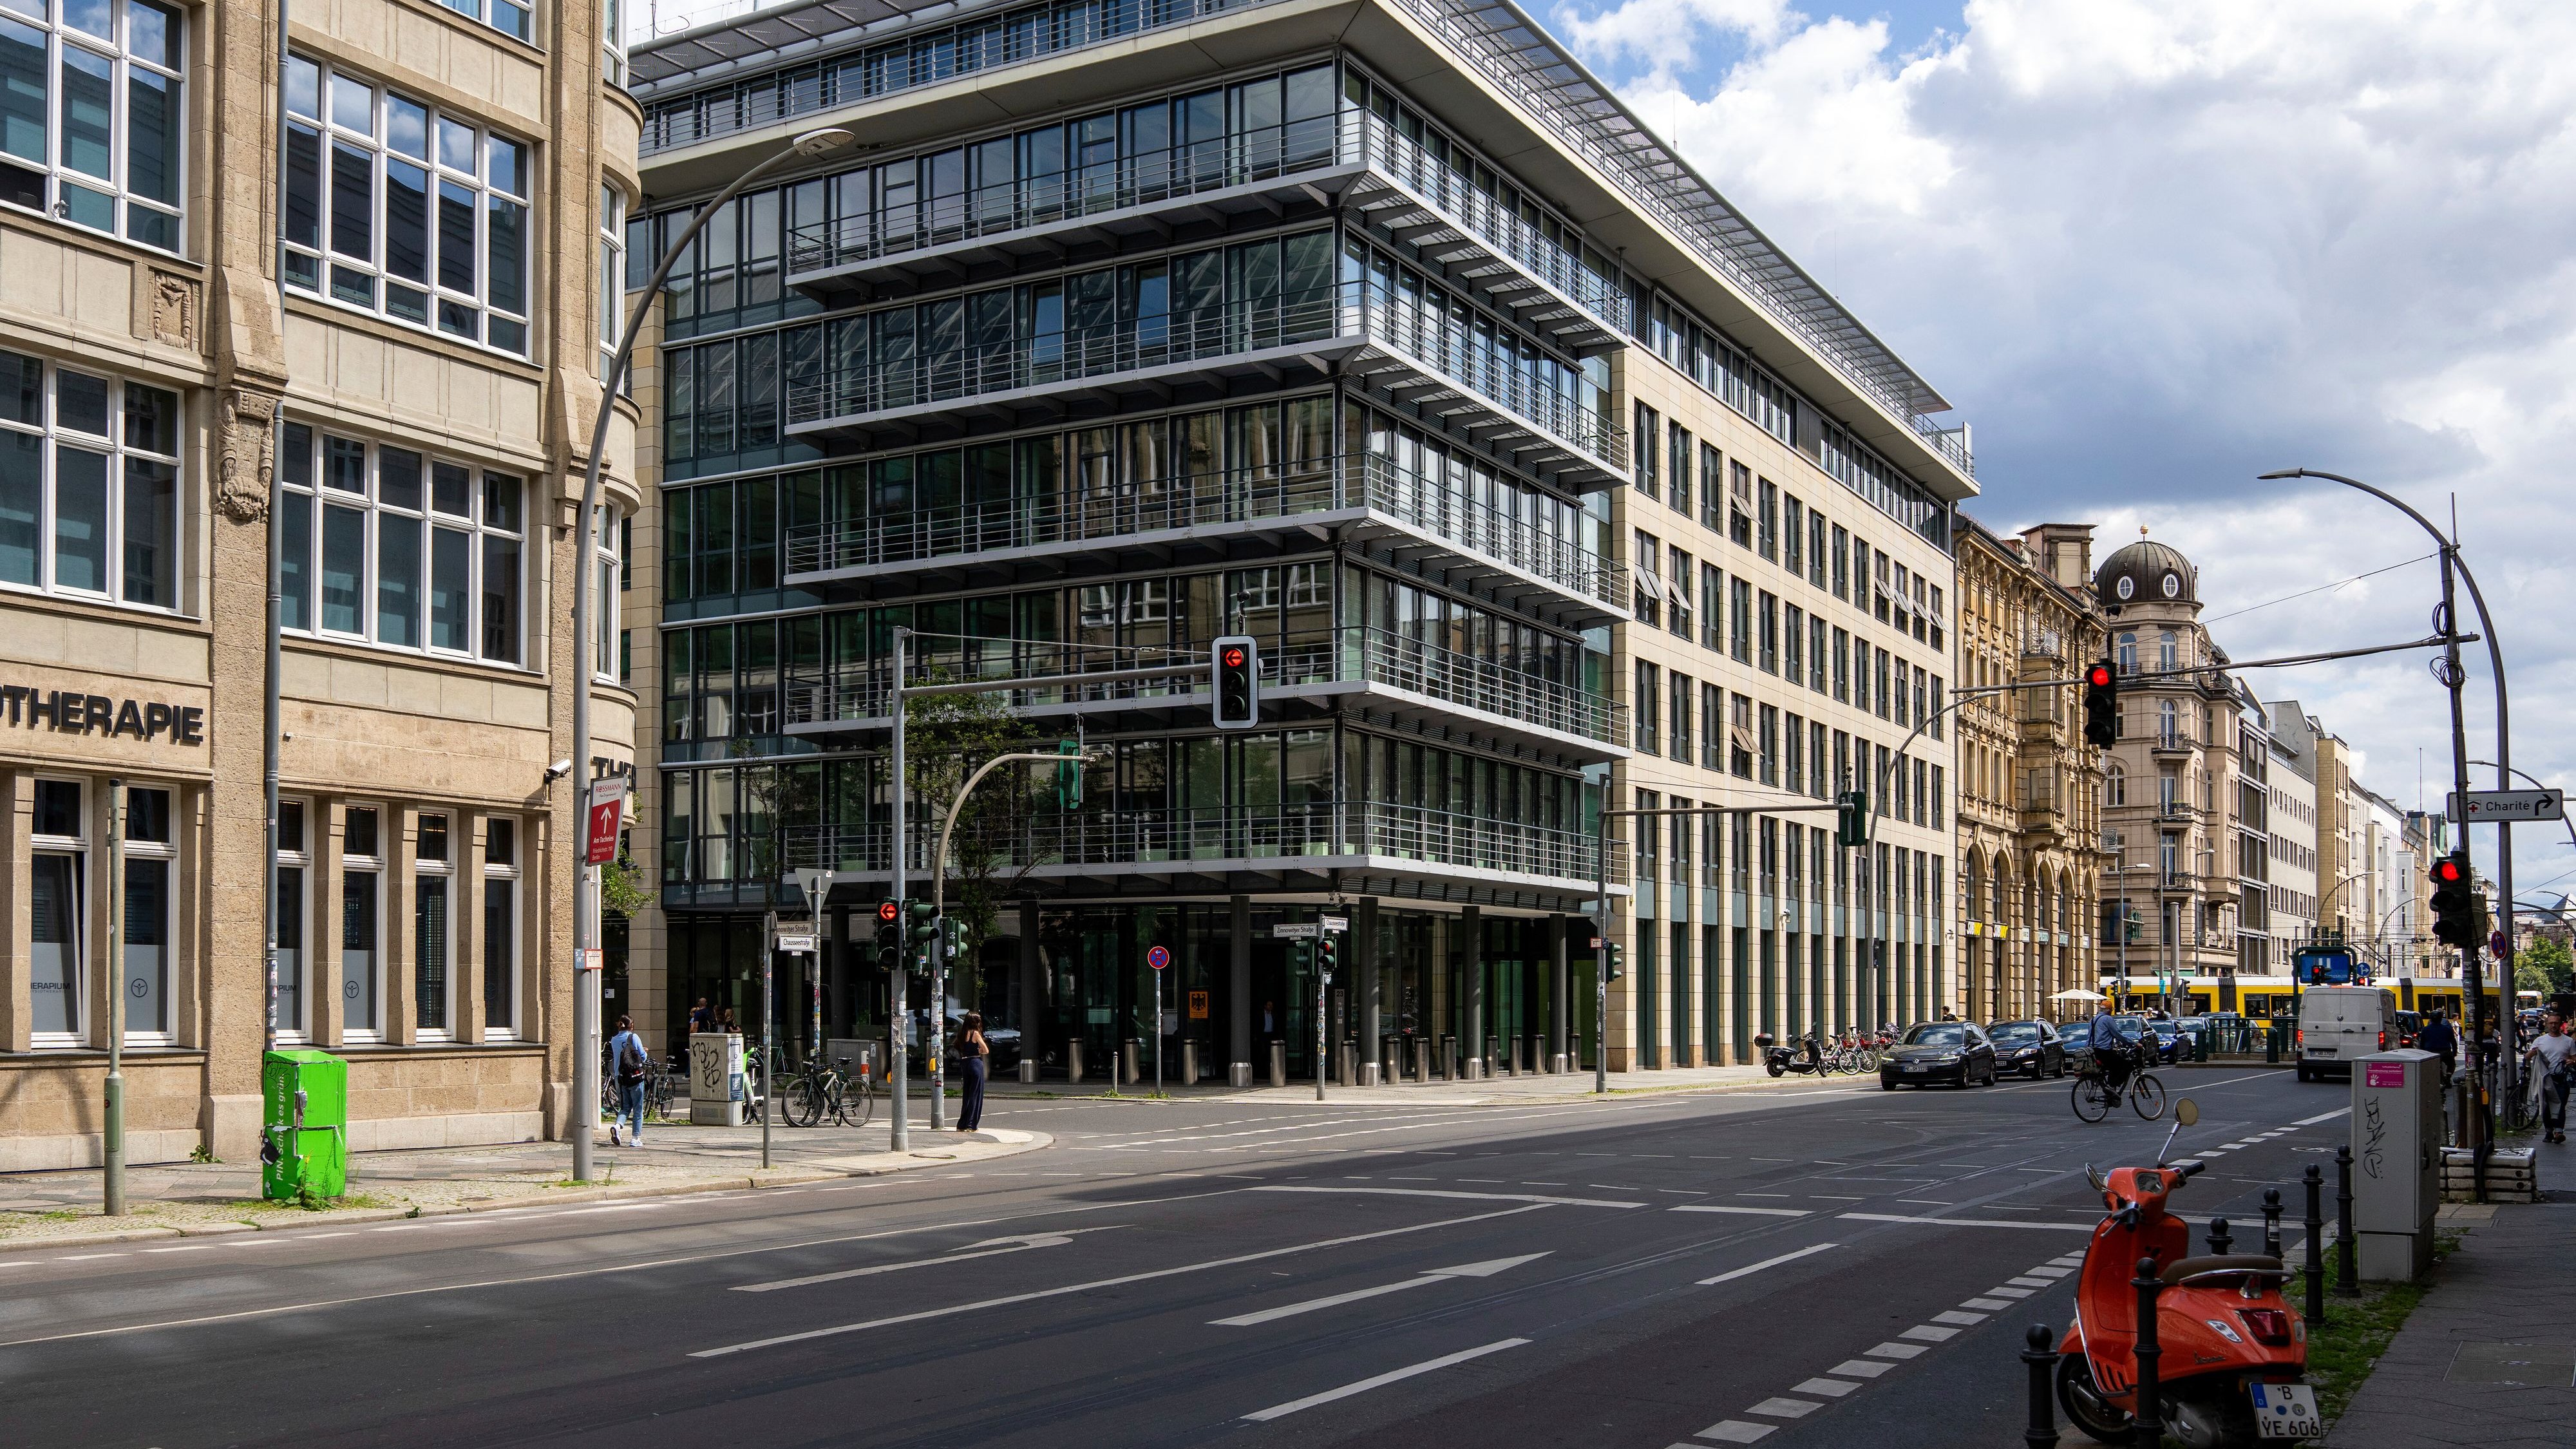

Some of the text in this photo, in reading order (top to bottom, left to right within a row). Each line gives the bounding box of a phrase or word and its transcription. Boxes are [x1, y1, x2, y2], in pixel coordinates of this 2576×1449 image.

[0, 685, 204, 742] THERAPIE
[596, 783, 621, 793] ROSSMANN
[2486, 800, 2530, 811] Charité
[795, 925, 808, 933] Straße
[783, 938, 810, 947] Chausseestraße
[278, 1104, 284, 1117] es
[2281, 1385, 2293, 1399] B
[2261, 1420, 2319, 1436] YE 606
